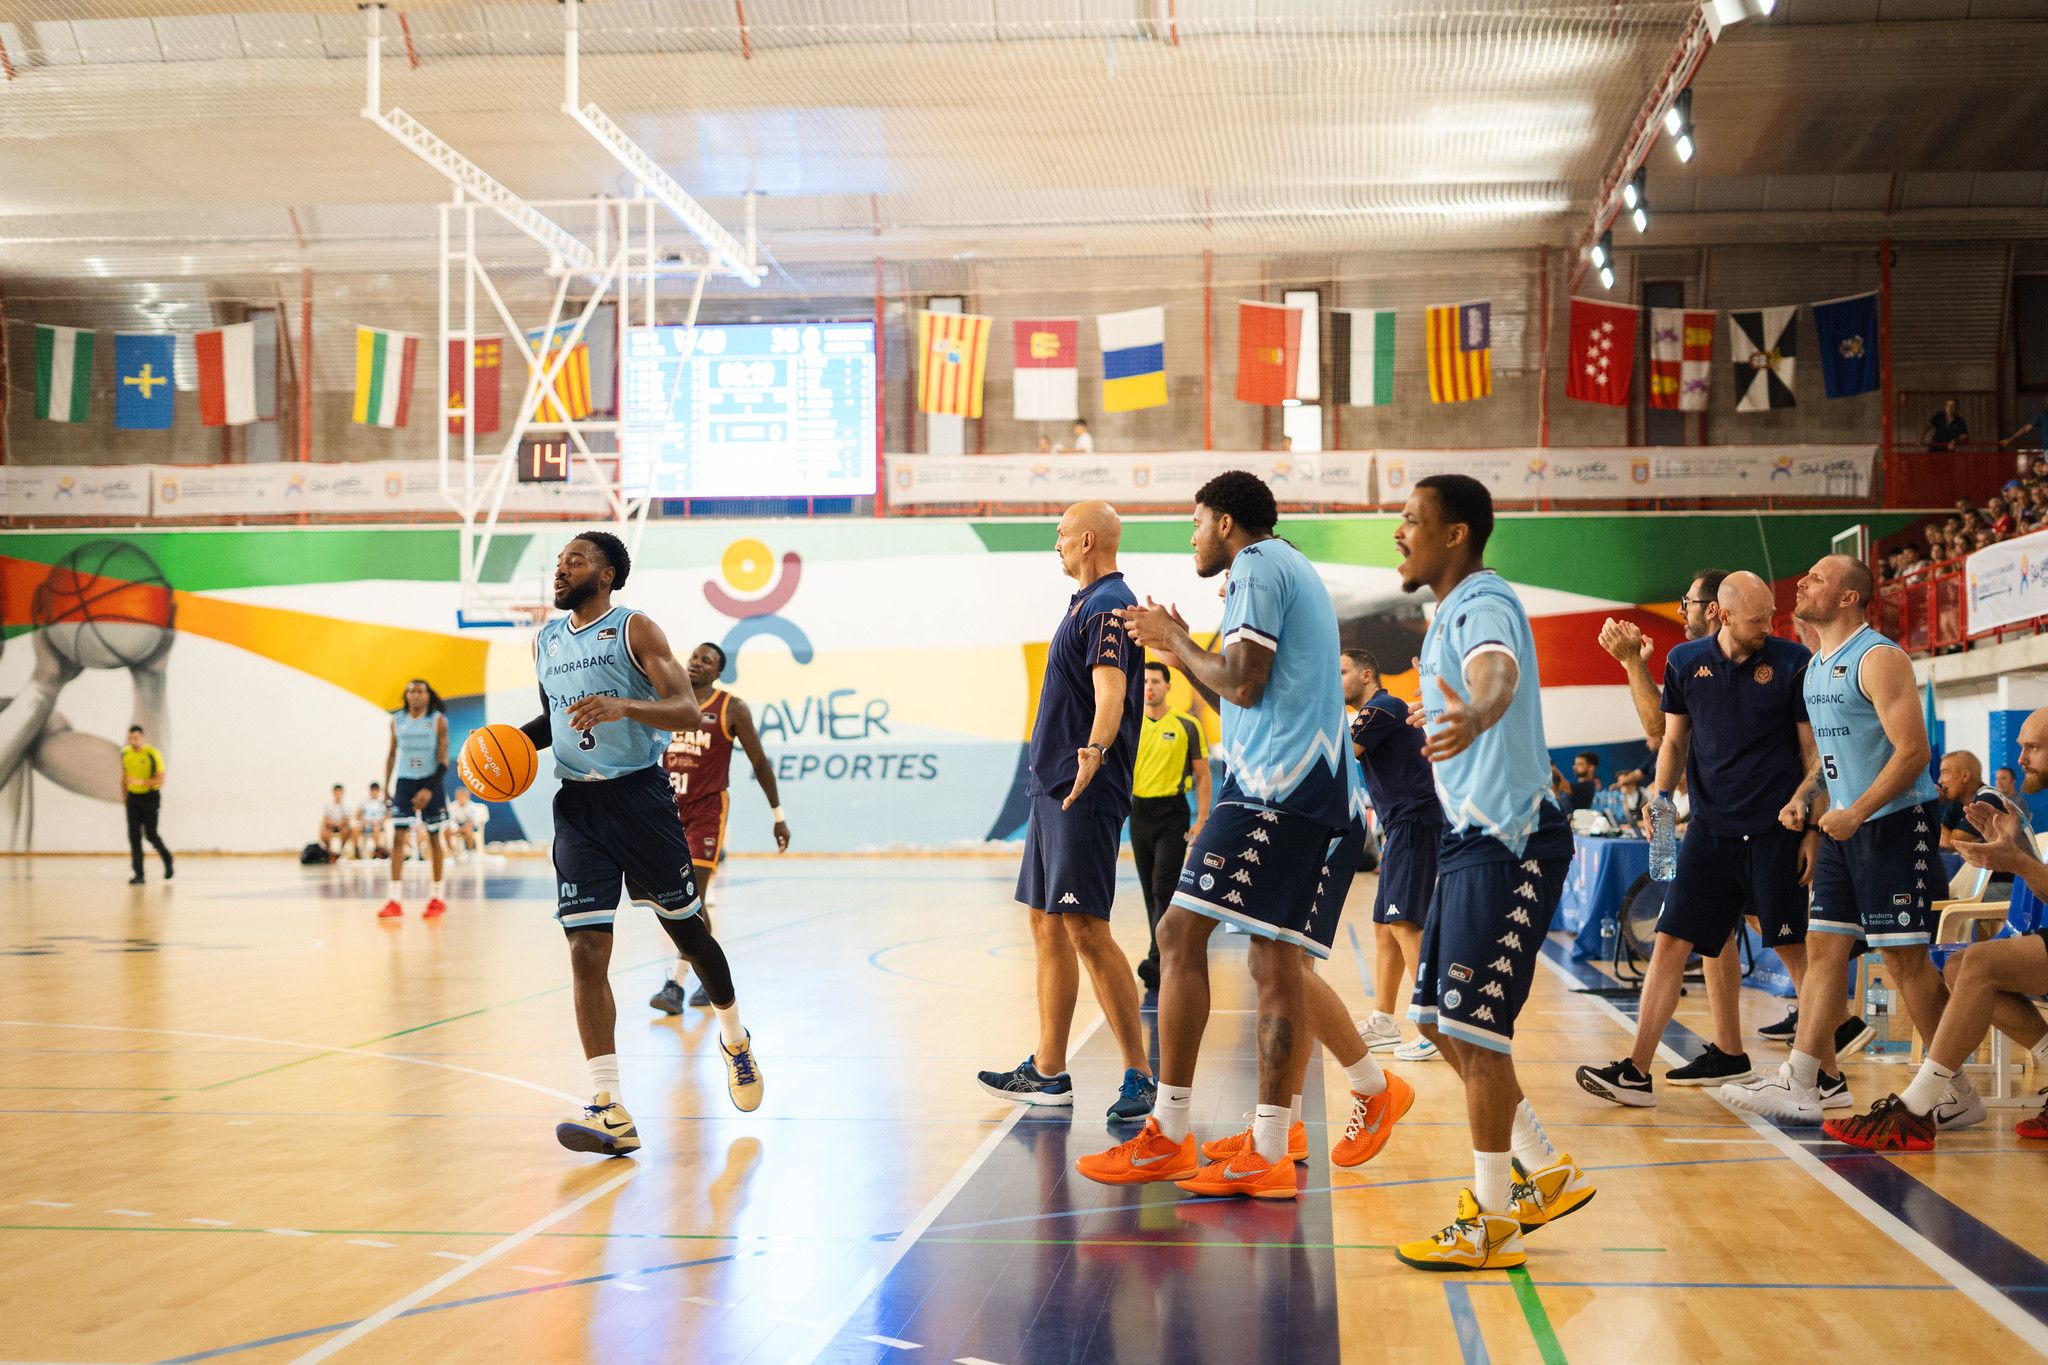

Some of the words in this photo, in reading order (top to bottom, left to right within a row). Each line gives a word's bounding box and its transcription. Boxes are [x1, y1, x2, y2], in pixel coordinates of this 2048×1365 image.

[533, 443, 567, 477] 14
[553, 654, 615, 676] MORABANC
[733, 690, 890, 751] AVIER
[577, 727, 597, 752] 3
[752, 754, 937, 781] EPORTES
[1823, 754, 1838, 780] 5
[1868, 912, 1893, 920] andorra
